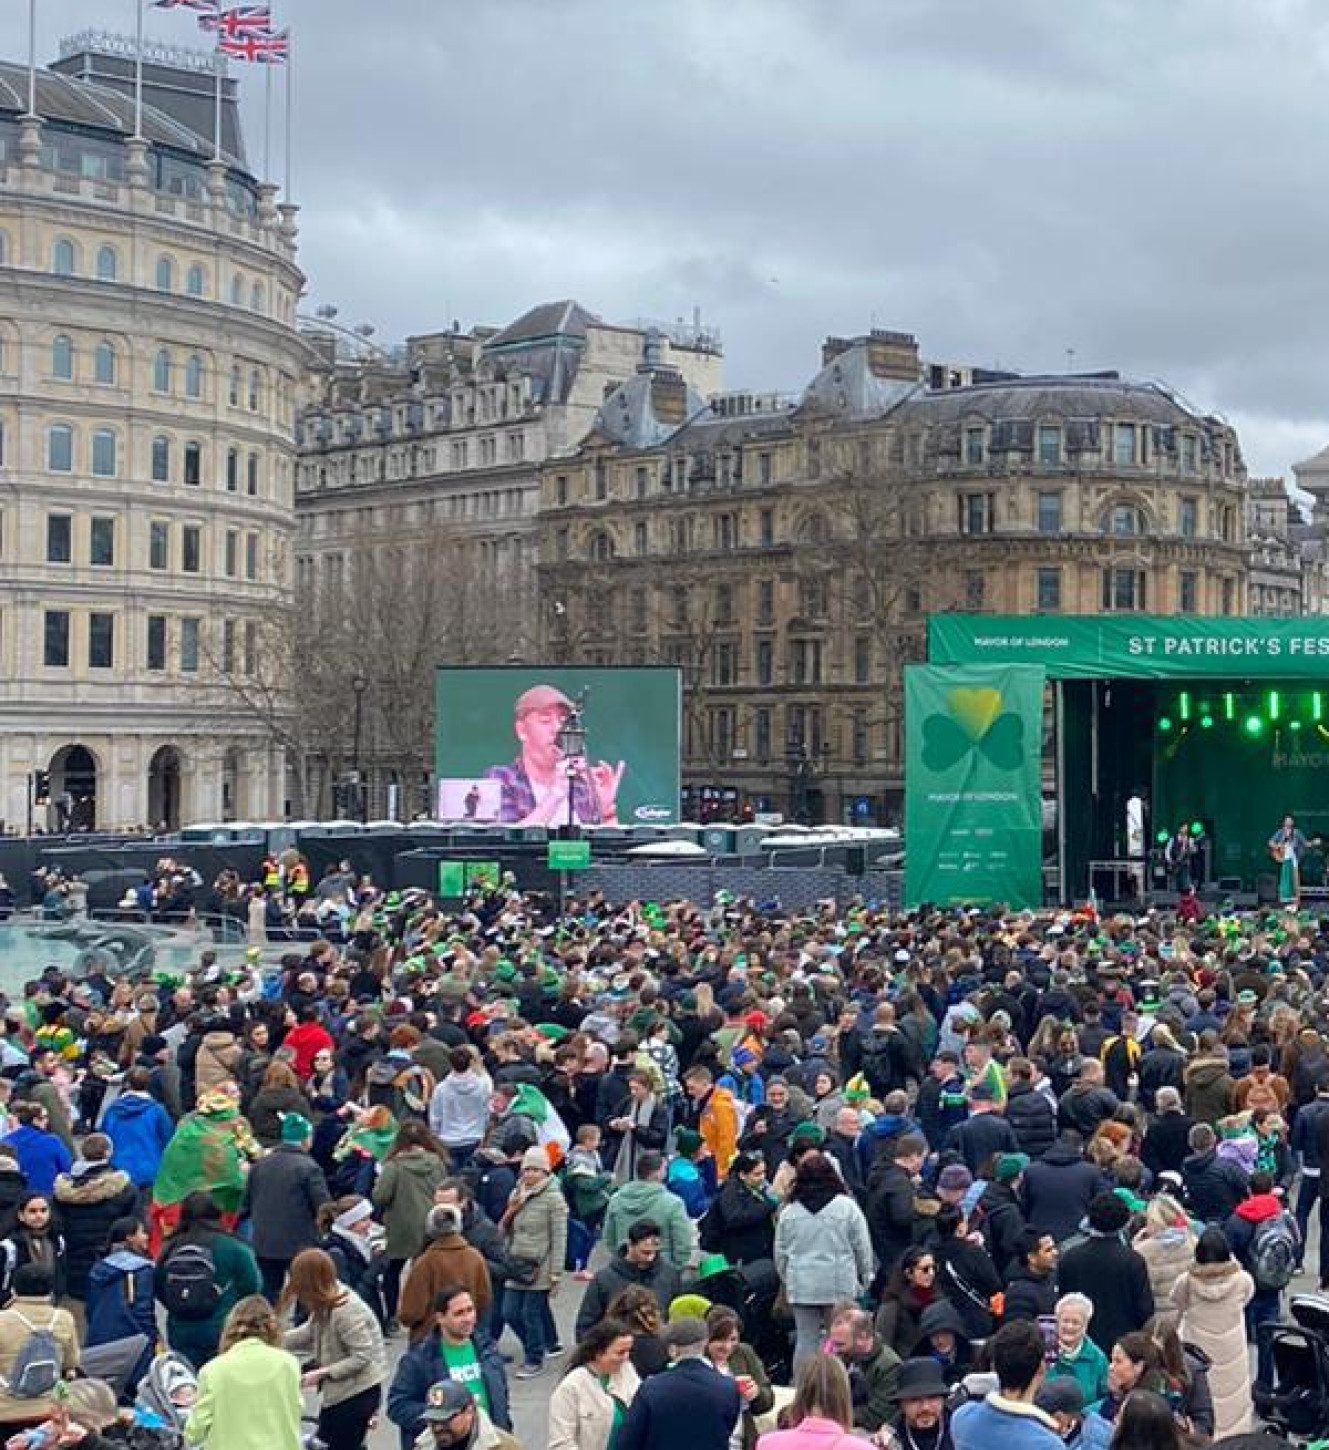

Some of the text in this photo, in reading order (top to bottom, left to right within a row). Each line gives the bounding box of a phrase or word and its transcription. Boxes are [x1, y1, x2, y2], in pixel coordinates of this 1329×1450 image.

[974, 638, 1069, 648] MAYOR OF LONDON
[1128, 637, 1156, 655] ST
[1164, 637, 1282, 655] PATRICK'S
